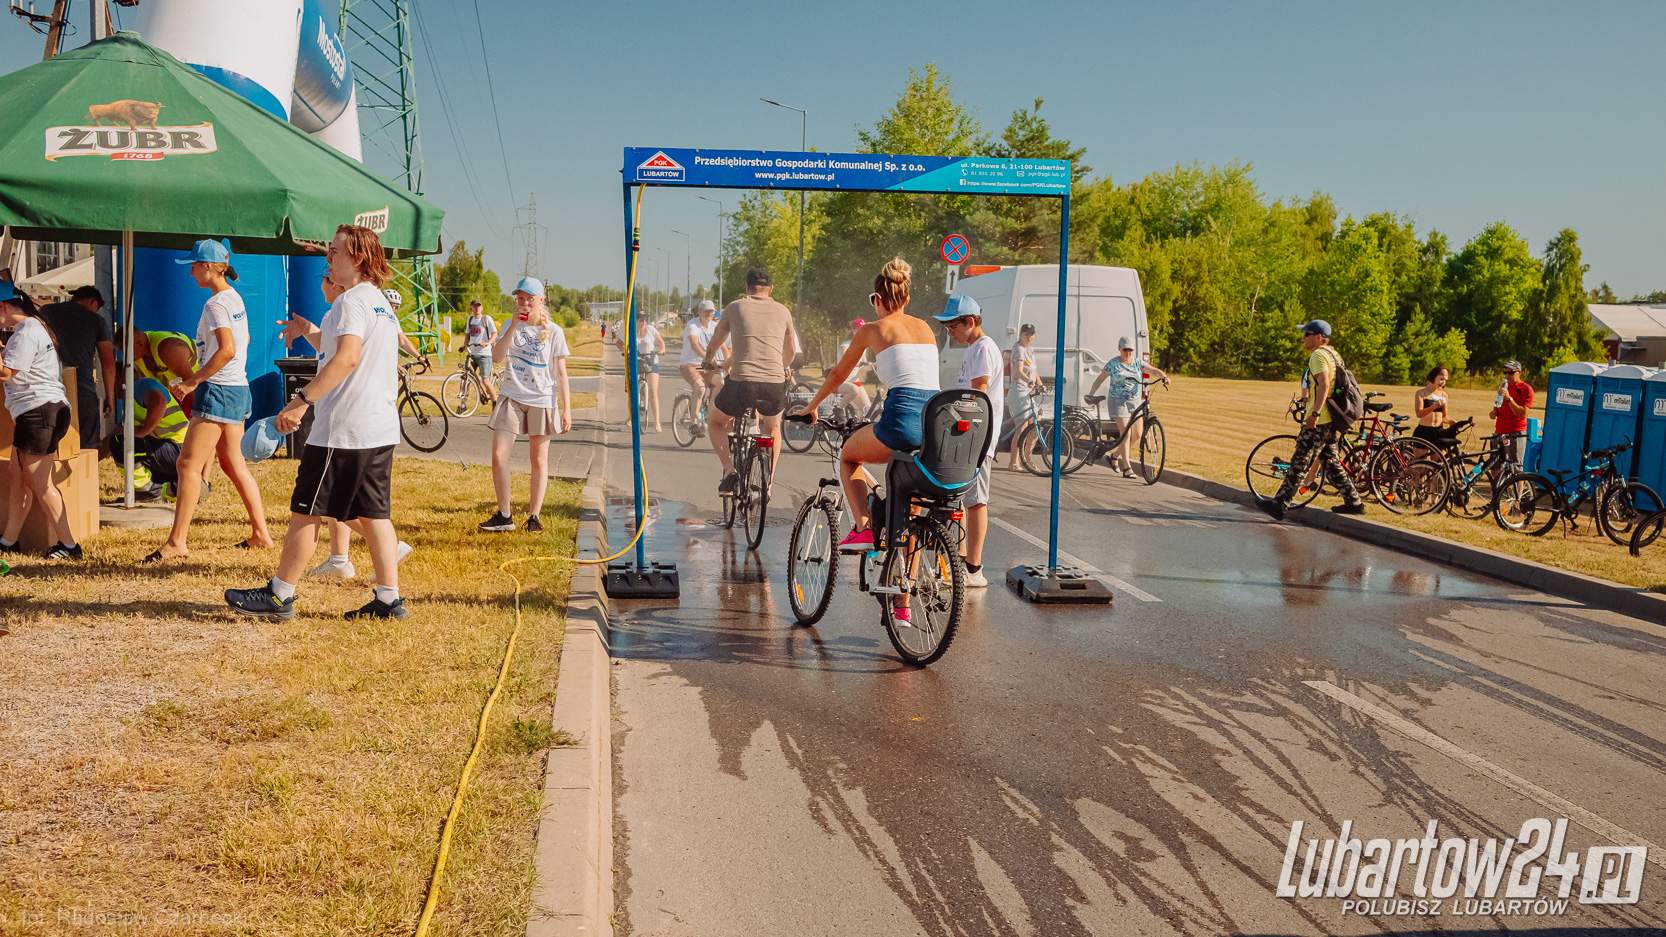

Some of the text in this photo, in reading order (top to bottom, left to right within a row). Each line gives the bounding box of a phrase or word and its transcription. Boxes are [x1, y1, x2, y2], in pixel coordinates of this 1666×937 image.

[58, 128, 207, 150] ŻUBR
[694, 156, 773, 168] Przedsiębiorstwo
[775, 158, 826, 169] Gospodarki
[828, 160, 882, 172] Komunalnej
[884, 162, 899, 172] Sp.
[909, 164, 926, 172] o.o.
[643, 170, 679, 178] LUBARTÓW
[755, 171, 835, 181] www.pgk.lubartow.pl
